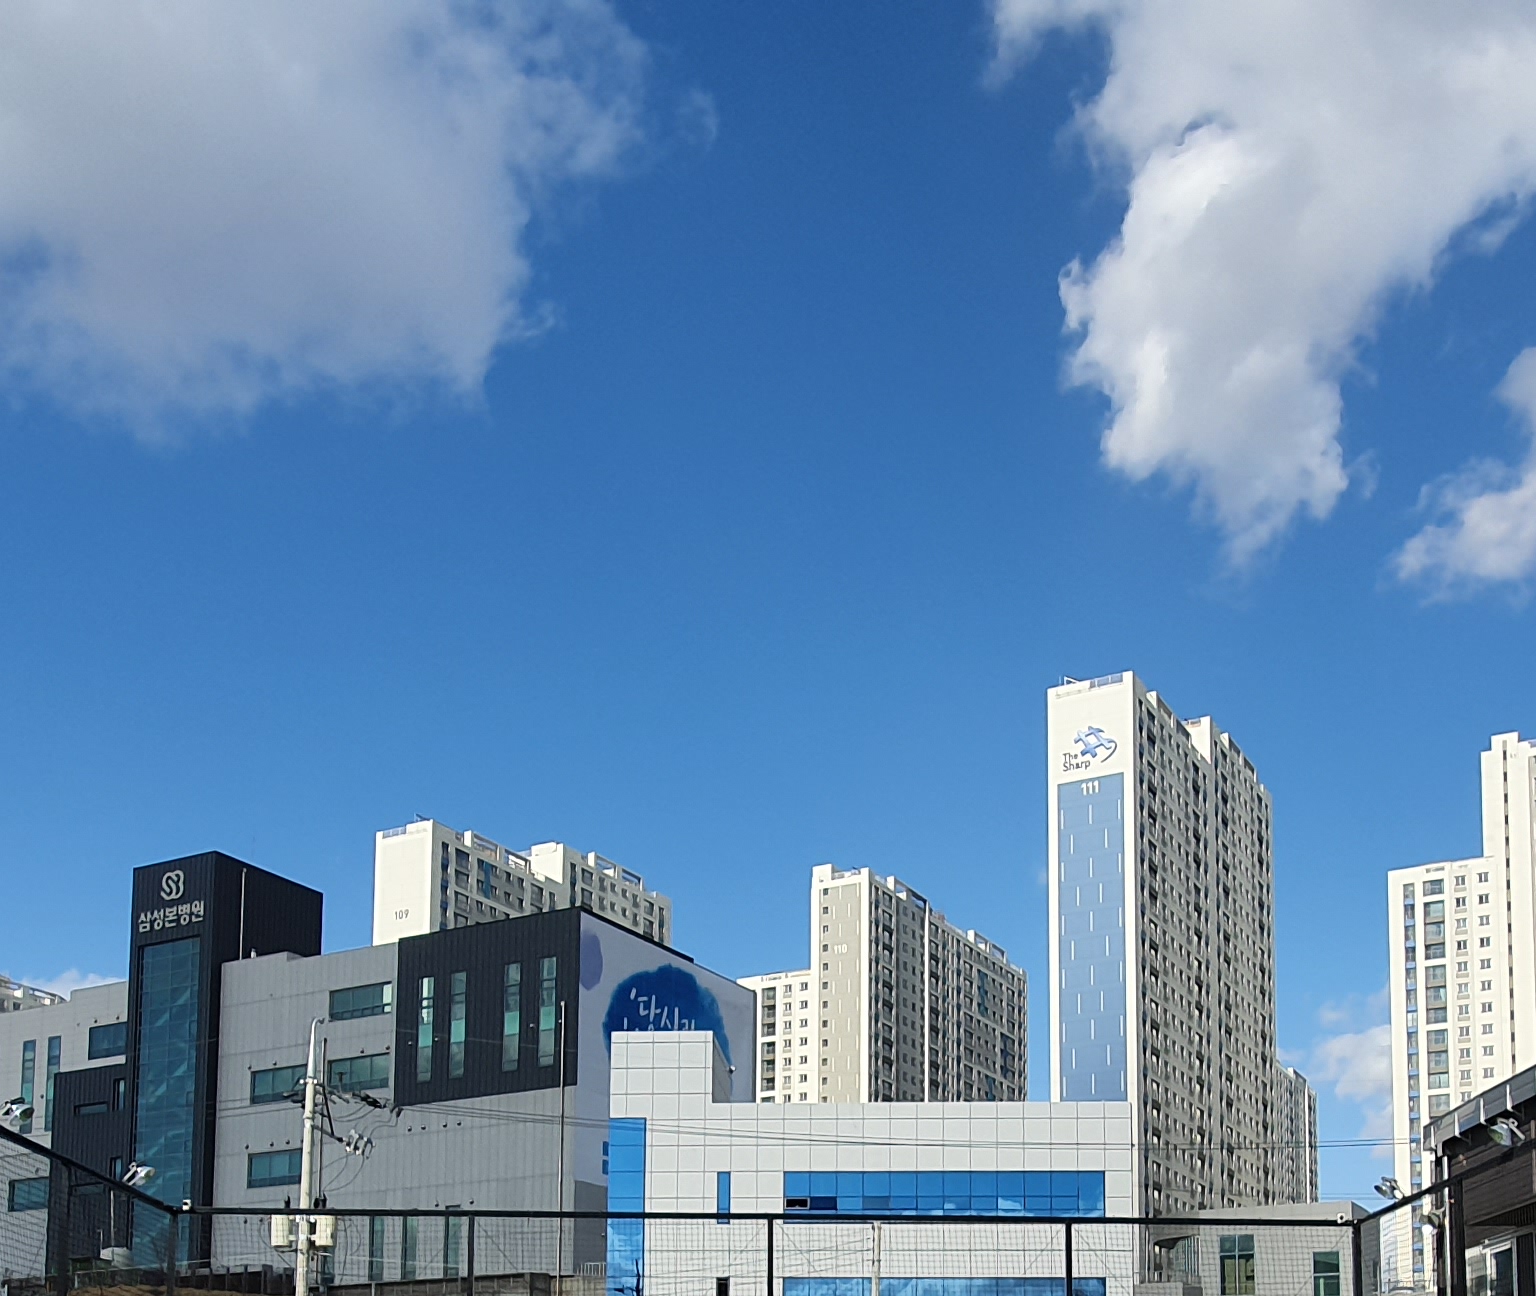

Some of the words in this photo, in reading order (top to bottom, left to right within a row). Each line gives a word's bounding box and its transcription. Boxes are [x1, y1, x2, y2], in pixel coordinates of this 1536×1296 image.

[1062, 752, 1078, 762] The
[1062, 760, 1091, 772] Sharp
[1081, 780, 1099, 796] 111
[138, 900, 204, 933] 삼성본병원
[394, 909, 410, 921] 109
[833, 943, 848, 955] 110
